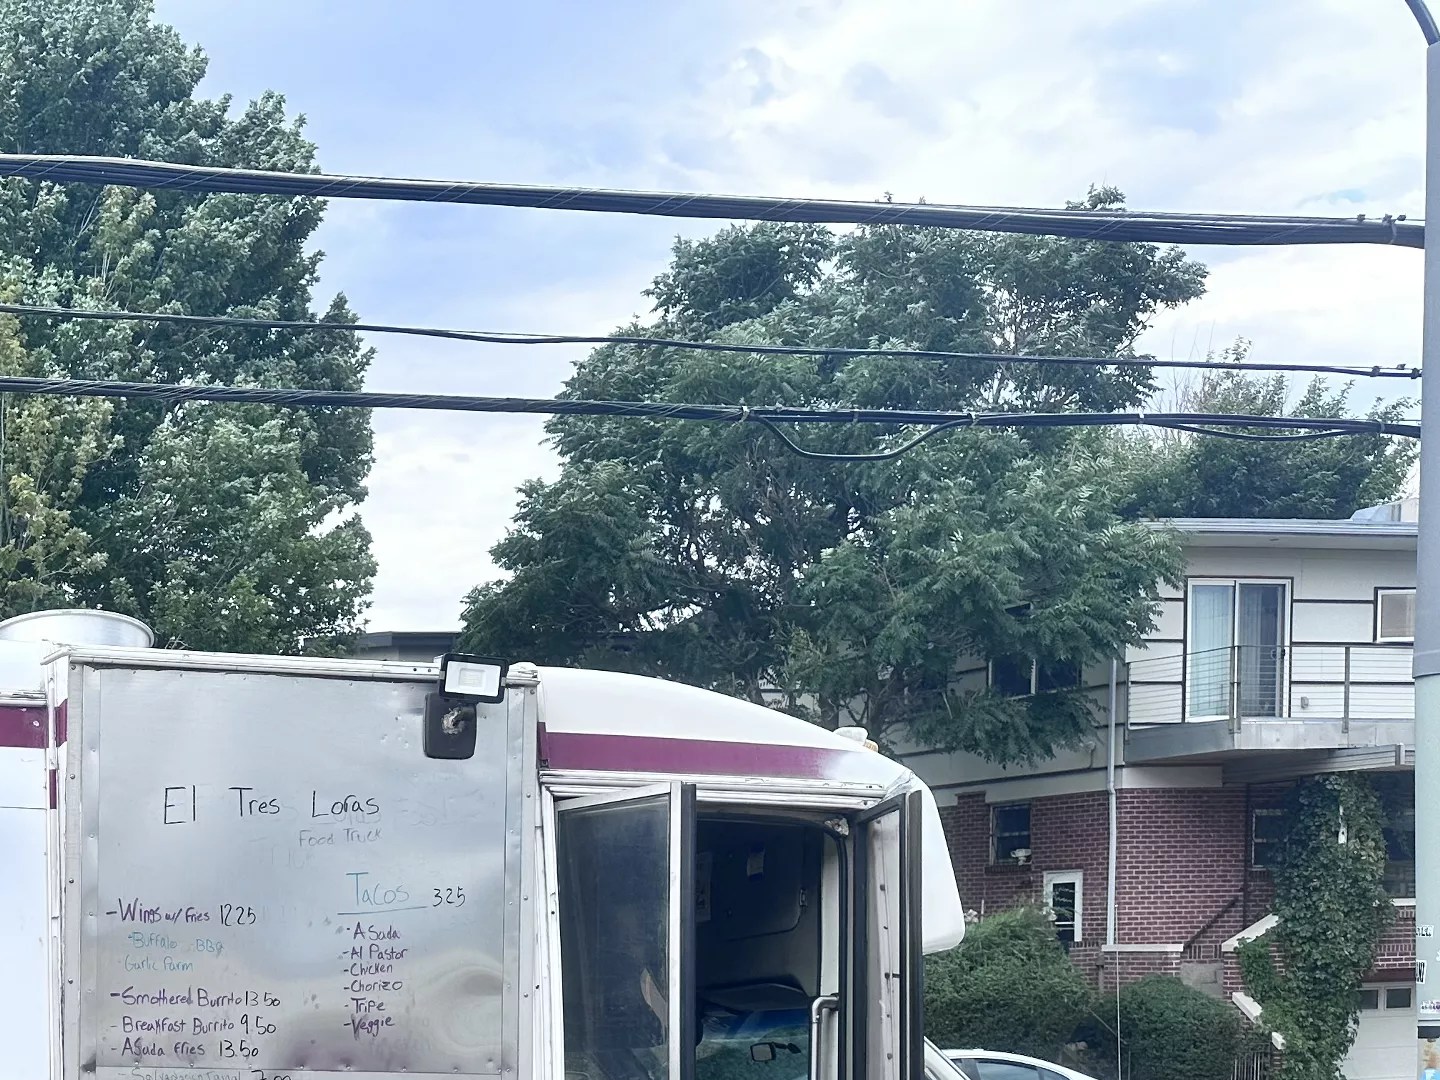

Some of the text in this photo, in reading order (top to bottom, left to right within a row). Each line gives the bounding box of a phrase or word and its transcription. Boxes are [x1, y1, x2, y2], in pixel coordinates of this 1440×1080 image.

[164, 785, 380, 824] El Tres Loras
[299, 827, 383, 847] Food Truck
[345, 872, 410, 906] Tacos
[369, 943, 409, 960] Pastor
[124, 954, 194, 972] Garlic Parm
[197, 988, 243, 1007] Burrito
[192, 1017, 235, 1036] Burrito
